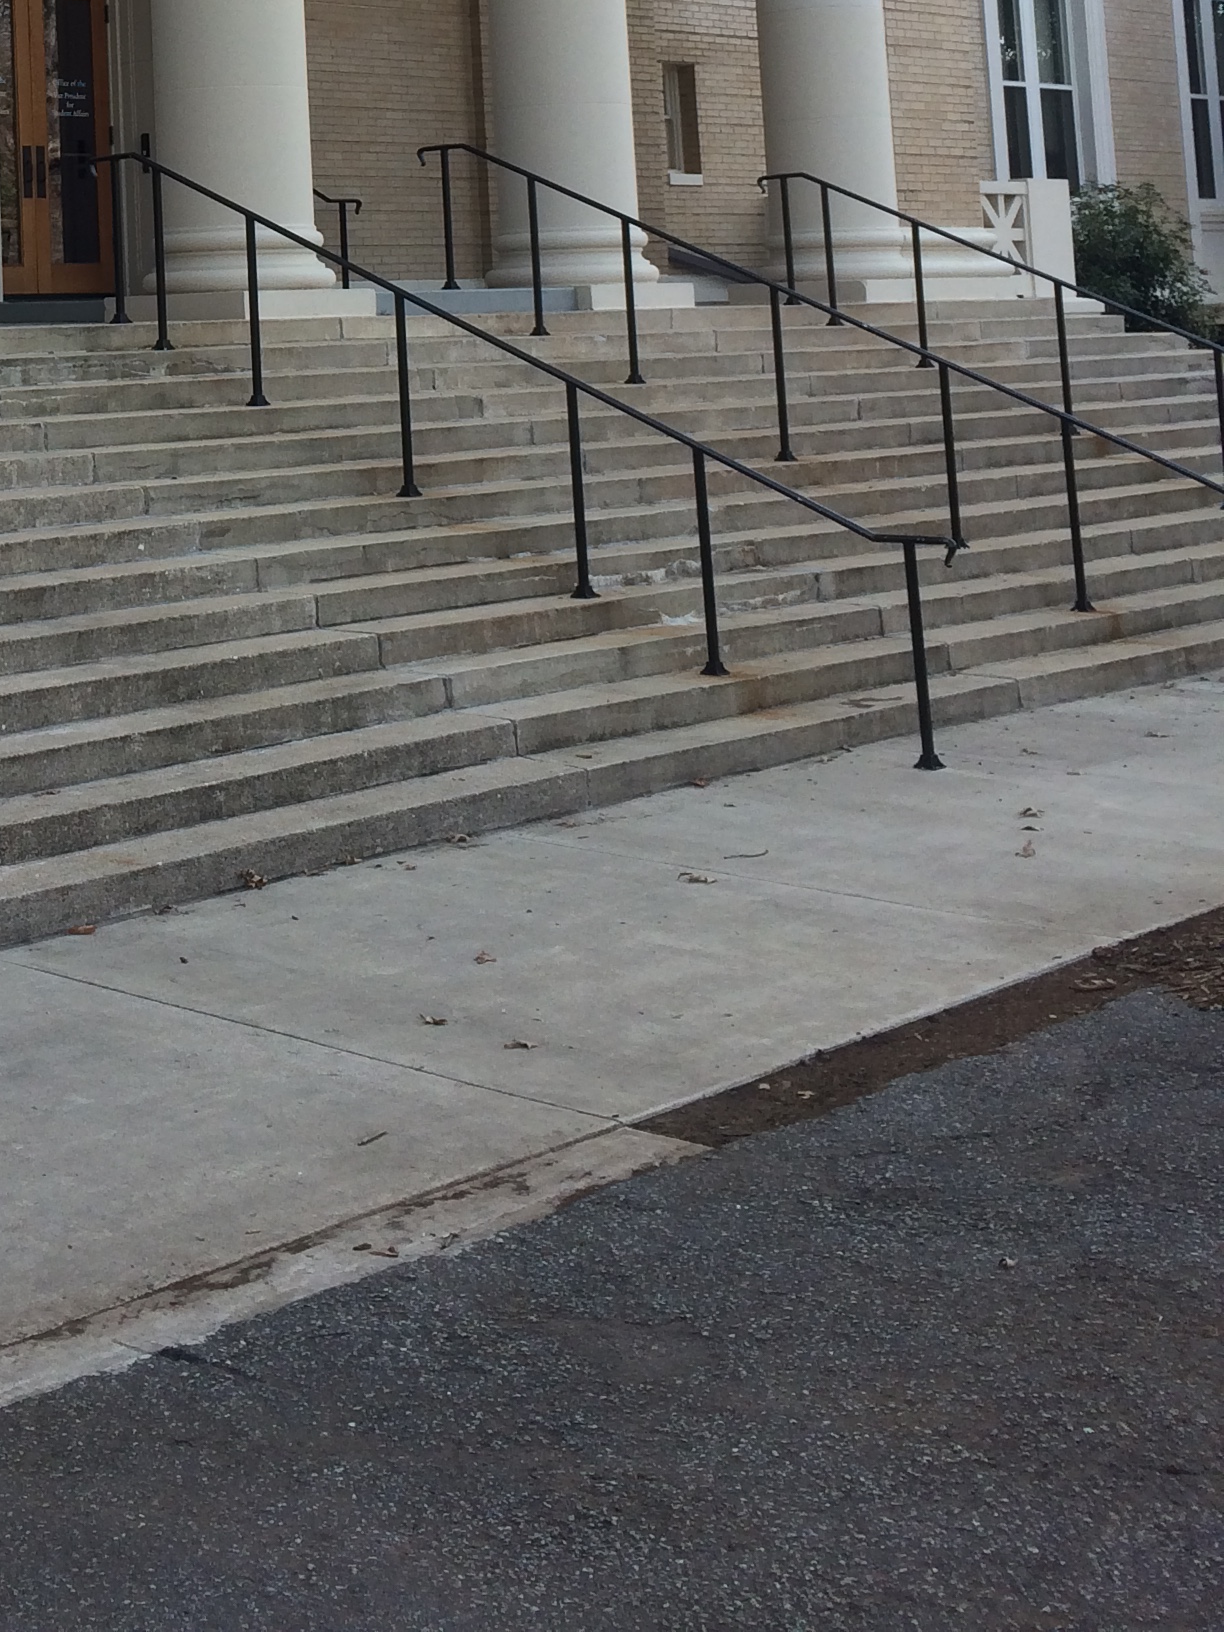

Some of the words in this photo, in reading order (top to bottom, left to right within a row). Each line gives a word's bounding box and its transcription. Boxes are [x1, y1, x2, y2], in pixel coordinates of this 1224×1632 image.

[70, 79, 77, 87] of
[77, 79, 87, 87] the
[66, 100, 75, 108] for
